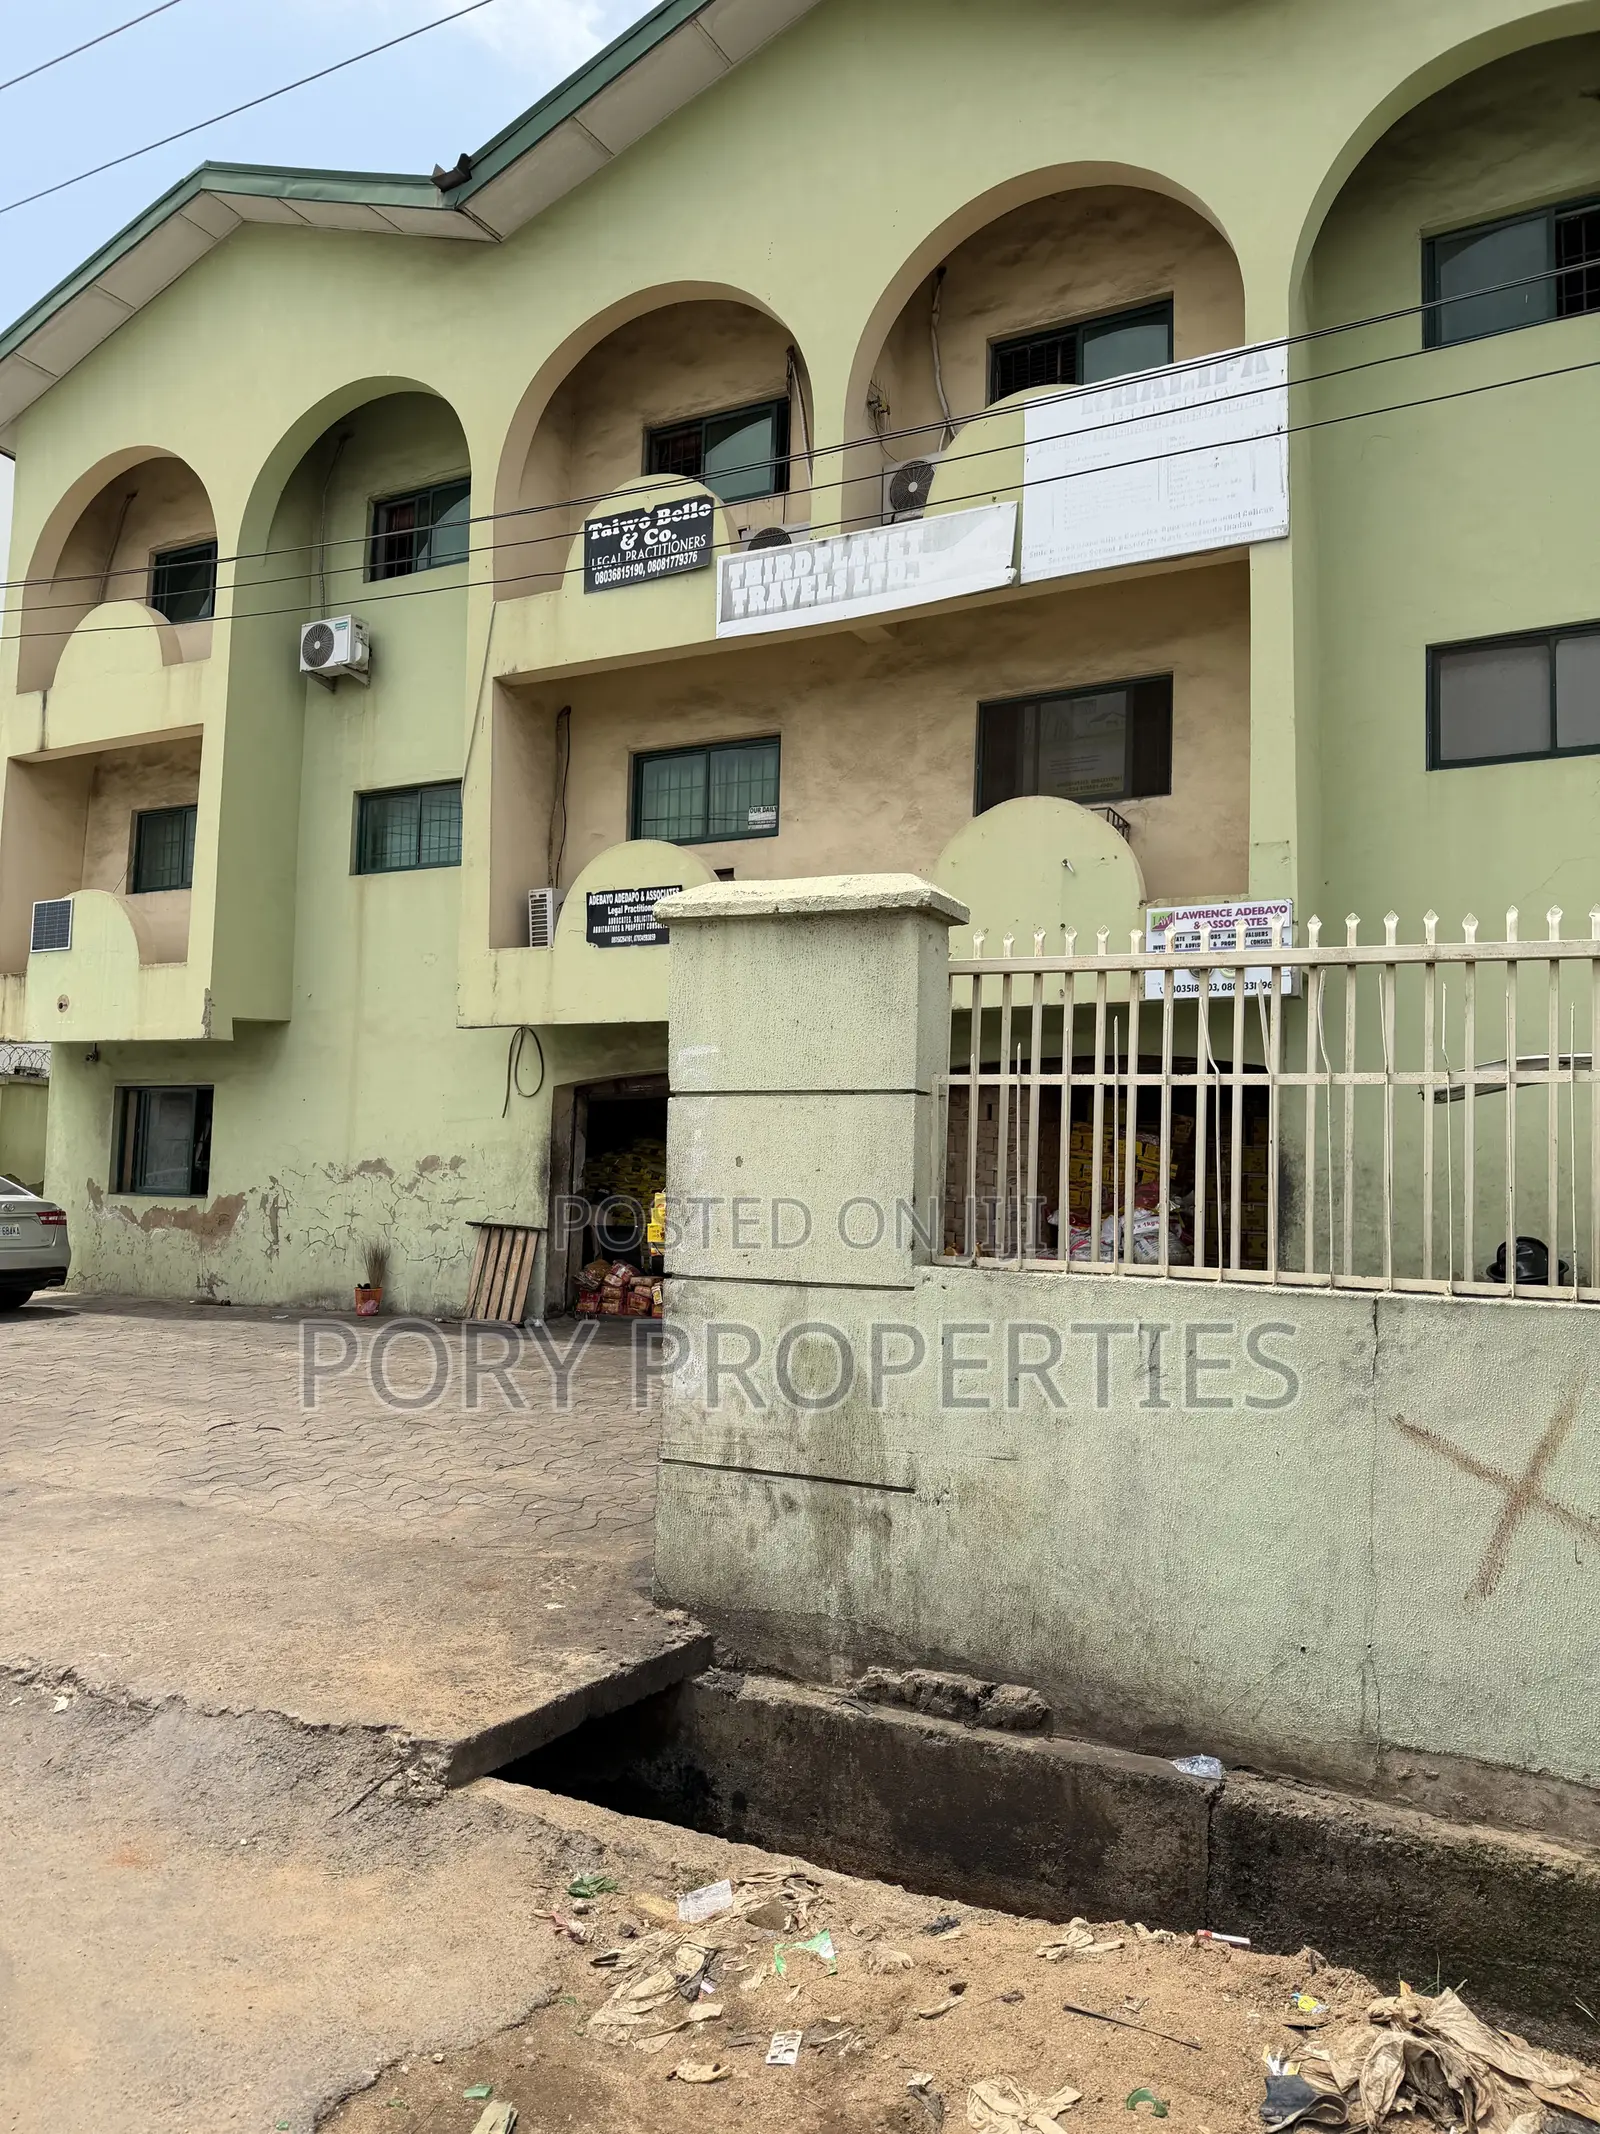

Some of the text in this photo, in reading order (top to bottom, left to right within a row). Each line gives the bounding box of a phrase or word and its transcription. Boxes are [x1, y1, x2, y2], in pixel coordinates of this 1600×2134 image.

[588, 502, 712, 539] Taiwo Bello
[620, 528, 677, 550] & Co.
[591, 534, 706, 571] LEGAL PRACTITIONERS
[732, 568, 847, 614] TRAVELS
[589, 893, 613, 906] ADEBAYO
[614, 891, 639, 904] ADEDAPO
[640, 890, 644, 902] &
[608, 903, 654, 917] Legal Practitione
[1176, 905, 1288, 921] LAWRENCE ADEBAYO
[1194, 917, 1268, 930] & SSOCTES
